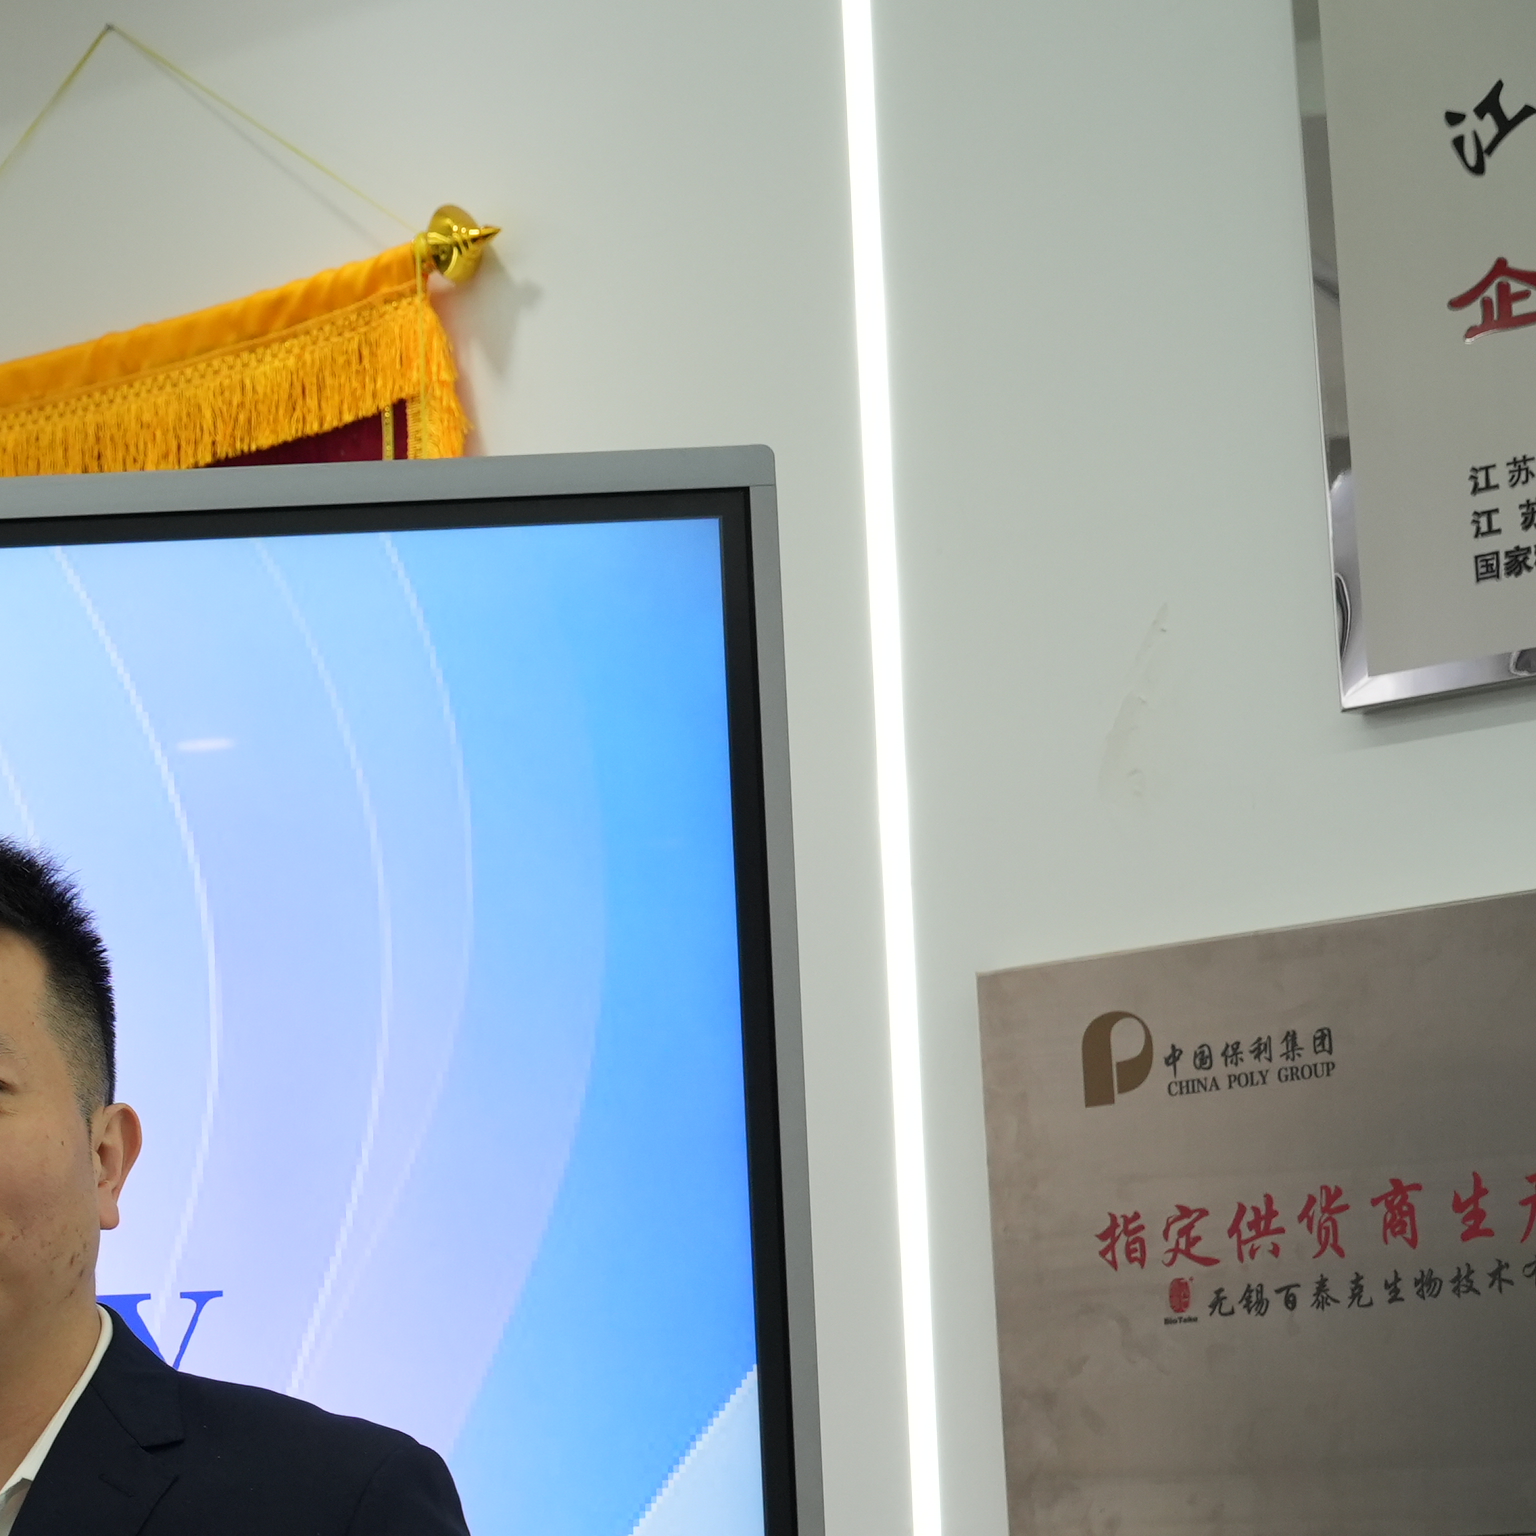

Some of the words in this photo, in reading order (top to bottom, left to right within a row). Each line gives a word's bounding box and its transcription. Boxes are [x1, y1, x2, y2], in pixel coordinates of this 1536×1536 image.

[1468, 454, 1535, 496] 江苏
[1473, 544, 1536, 583] 国家
[1164, 1026, 1335, 1078] 中国保利集团
[1167, 1076, 1221, 1097] CHINA
[1228, 1069, 1270, 1089] POLY
[1278, 1061, 1336, 1083] GROUP
